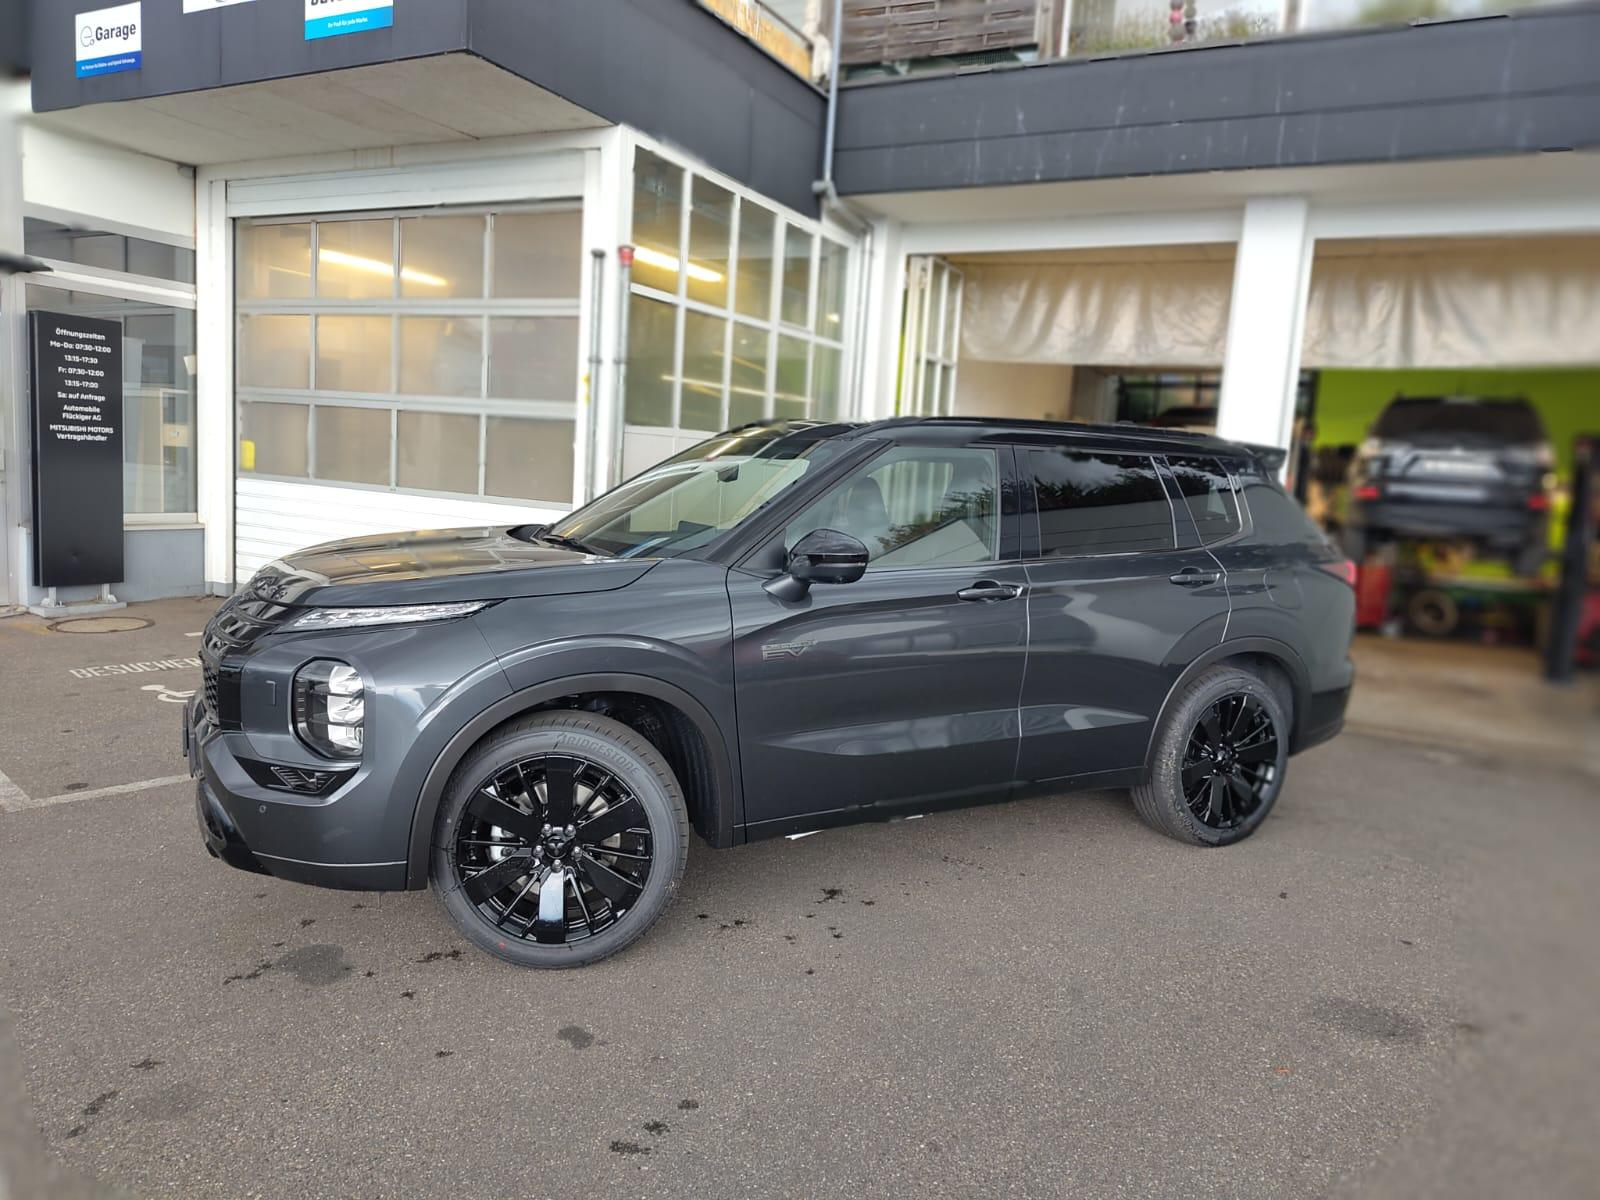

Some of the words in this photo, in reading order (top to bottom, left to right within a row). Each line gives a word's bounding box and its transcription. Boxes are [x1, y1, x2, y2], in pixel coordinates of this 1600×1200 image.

[95, 24, 136, 41] Garage
[55, 328, 105, 340] Öffnungszeiten
[50, 340, 74, 349] Mo-Do:
[75, 343, 111, 353] 07:30-12:00
[64, 354, 98, 364] 13:15-17:30
[58, 366, 67, 374] Fr:
[68, 367, 104, 377] 07:30-12:00
[64, 379, 98, 389] 13:15-17:00
[80, 393, 105, 402] Anfrage
[63, 404, 100, 413] Automobile
[62, 413, 92, 421] Flückiger
[50, 424, 86, 432] MITSUBISHI
[88, 426, 113, 434] MOTORS
[56, 433, 107, 441] Vertragshändler
[69, 658, 203, 678] BESUCHER
[555, 732, 640, 776] BRIDGESTONE
